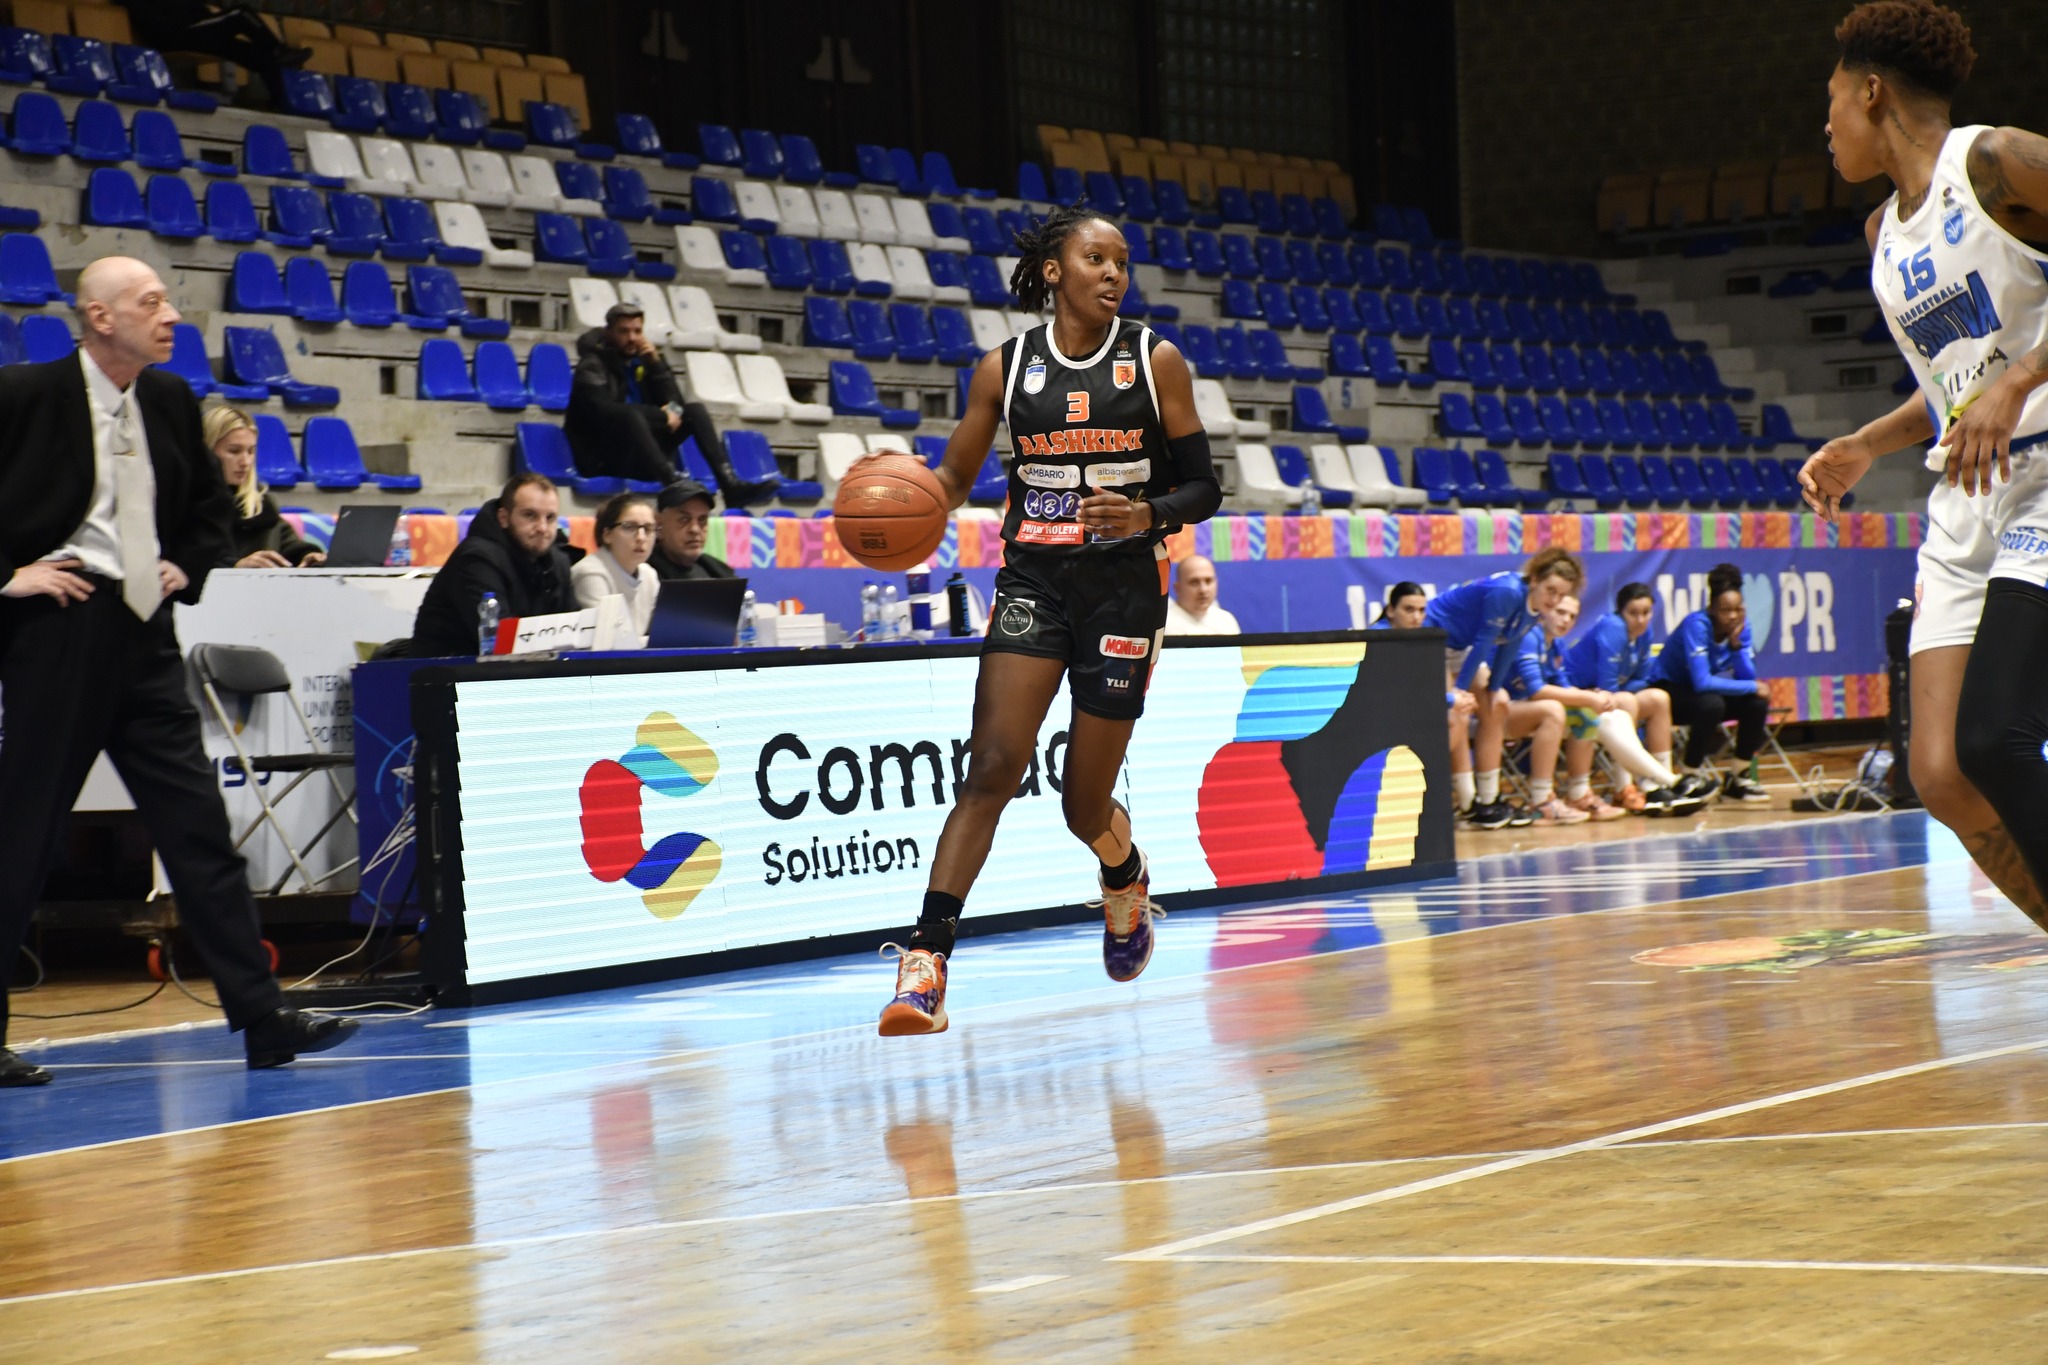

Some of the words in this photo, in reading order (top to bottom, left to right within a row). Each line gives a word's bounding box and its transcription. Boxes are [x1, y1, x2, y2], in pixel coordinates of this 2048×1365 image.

[1898, 243, 1937, 302] 15
[1901, 281, 1964, 325] BASKETBALL
[1066, 391, 1090, 422] 3
[1018, 429, 1144, 456] BASHKIMI
[1046, 525, 1079, 535] ROLETA
[1778, 571, 1837, 653] PR
[1106, 677, 1130, 688] YLLI
[763, 829, 920, 886] Solution
